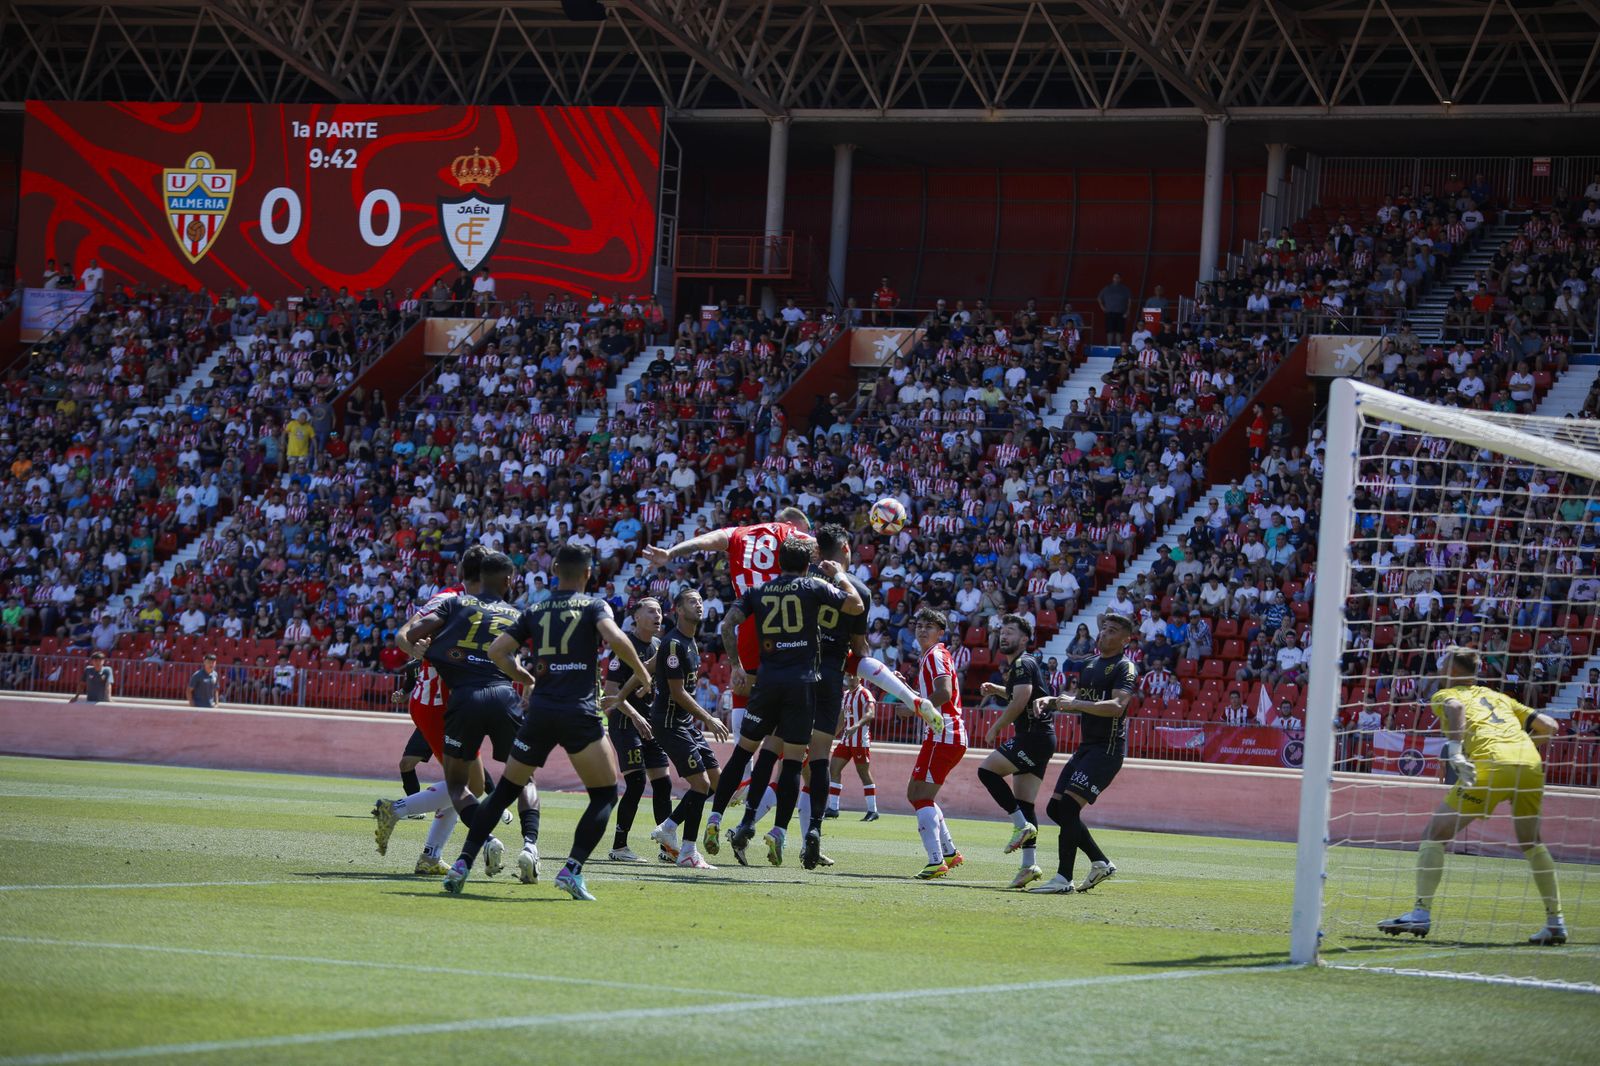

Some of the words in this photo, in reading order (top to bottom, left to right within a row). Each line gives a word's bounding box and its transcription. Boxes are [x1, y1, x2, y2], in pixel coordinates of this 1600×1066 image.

[292, 121, 311, 138] 1a
[315, 121, 379, 139] PARTE
[309, 148, 358, 169] 9:42
[171, 175, 187, 189] U
[210, 175, 227, 189] D
[169, 198, 226, 210] ALMERIA
[457, 204, 491, 215] JAÉN
[260, 187, 302, 245] 0
[359, 188, 402, 247] 0
[742, 533, 778, 570] 18
[764, 582, 799, 593] MAURO
[461, 599, 477, 607] DE
[761, 594, 804, 634] 20
[538, 609, 583, 656] 17
[776, 640, 808, 649] Candela
[549, 662, 588, 672] Candela
[1480, 696, 1506, 724] 1
[627, 749, 642, 765] 18
[688, 754, 698, 769] 6
